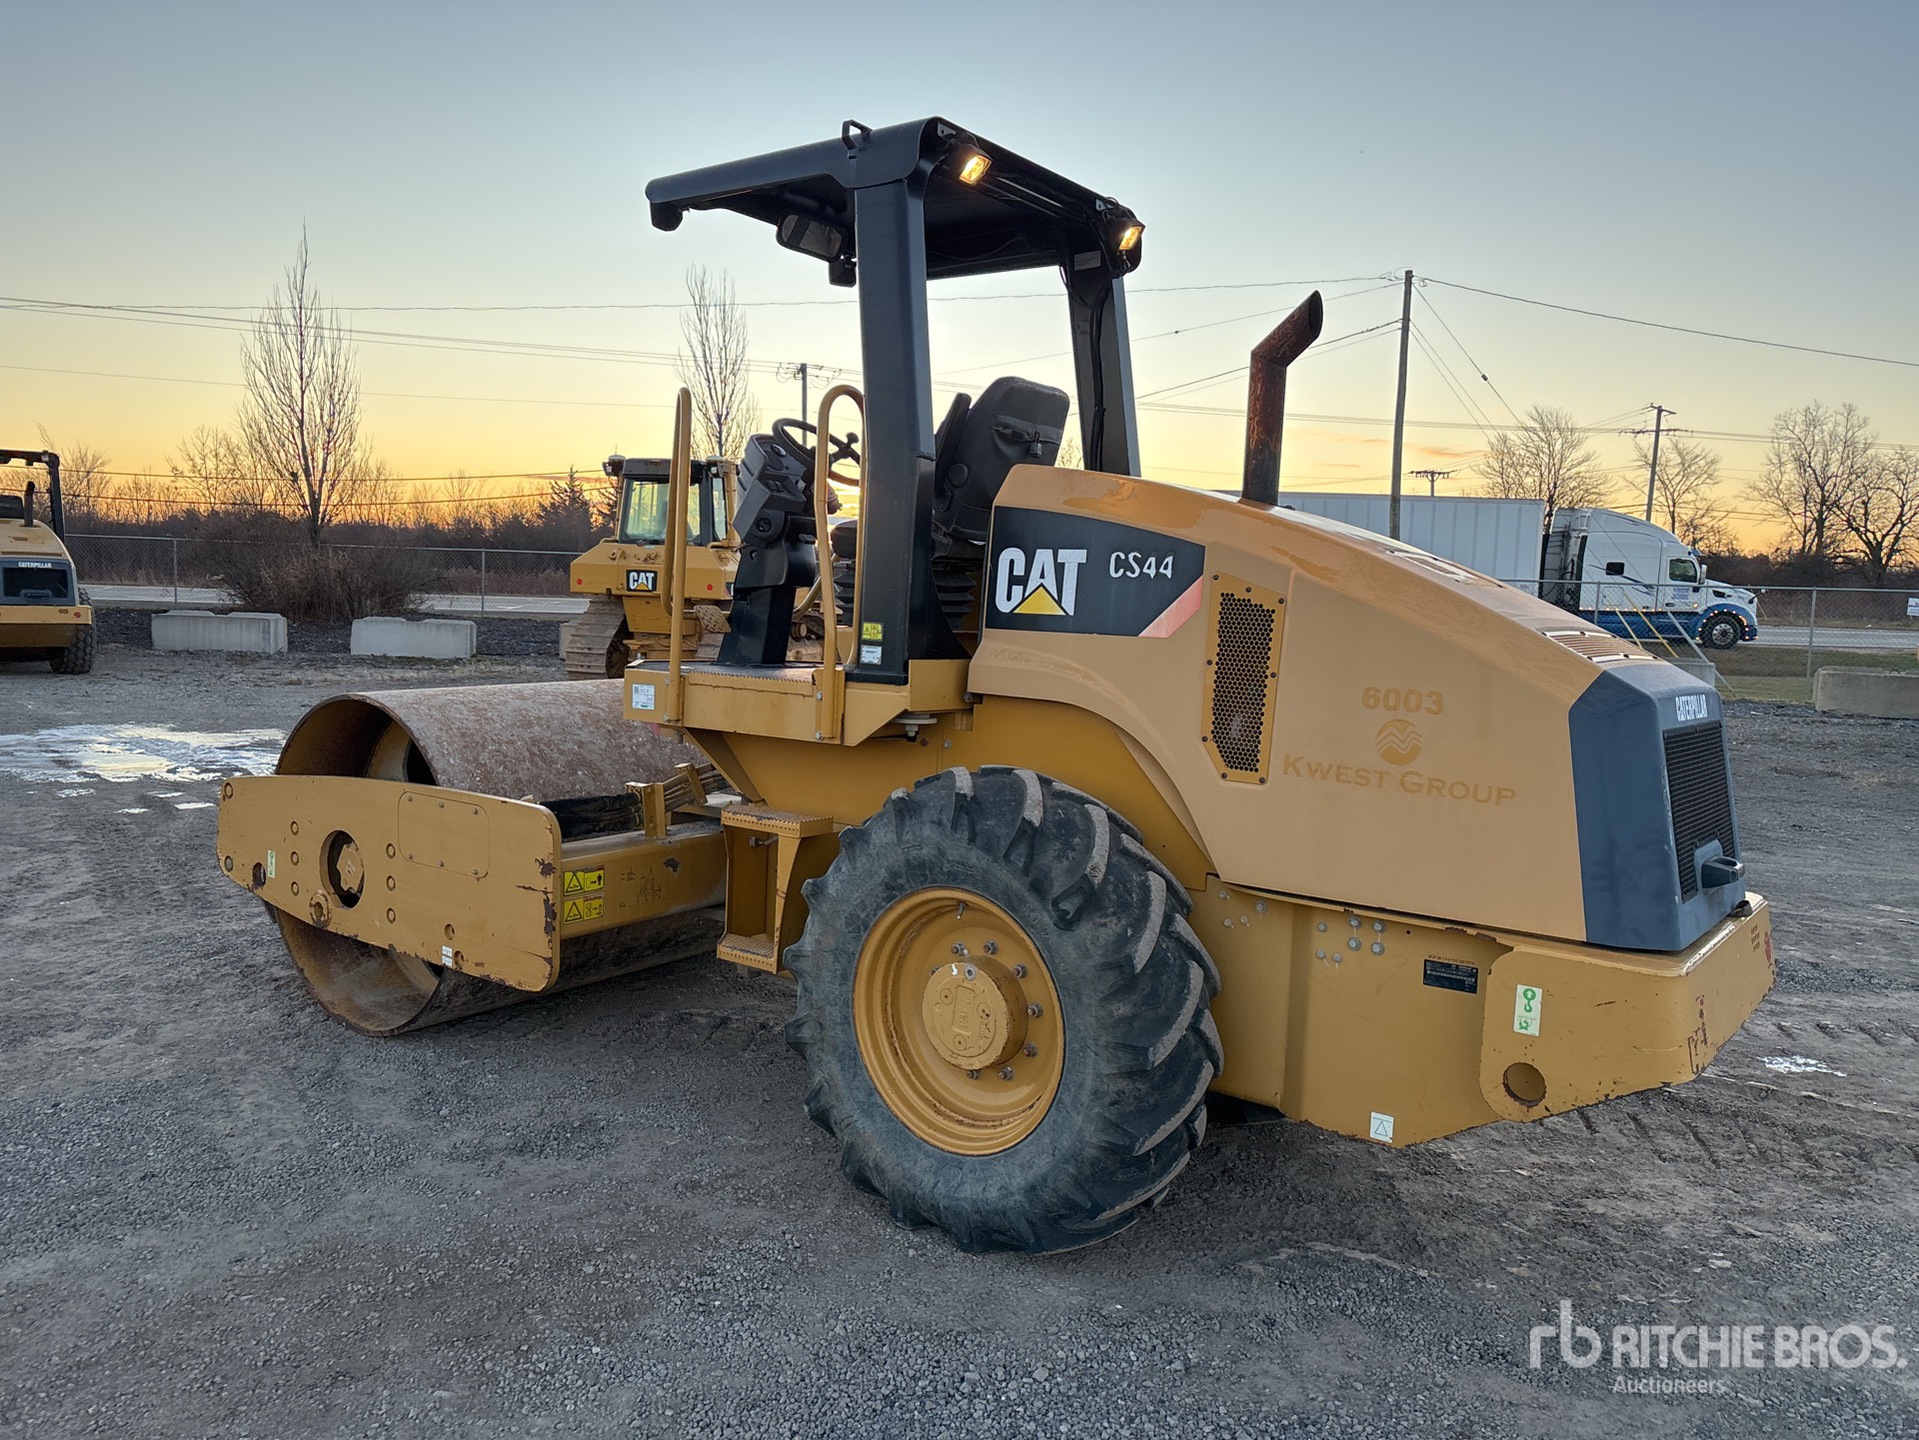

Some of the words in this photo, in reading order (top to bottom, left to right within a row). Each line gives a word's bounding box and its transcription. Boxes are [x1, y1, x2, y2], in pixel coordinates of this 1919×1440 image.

[18, 561, 52, 569] CATERPILLAR
[629, 571, 655, 591] CAT
[995, 547, 1087, 616] CAT
[1109, 551, 1174, 579] CS44
[1361, 686, 1445, 715] 6003
[1675, 693, 1708, 721] CATERPILLAR
[1282, 754, 1391, 789] KWEST
[1399, 770, 1517, 806] GROUP
